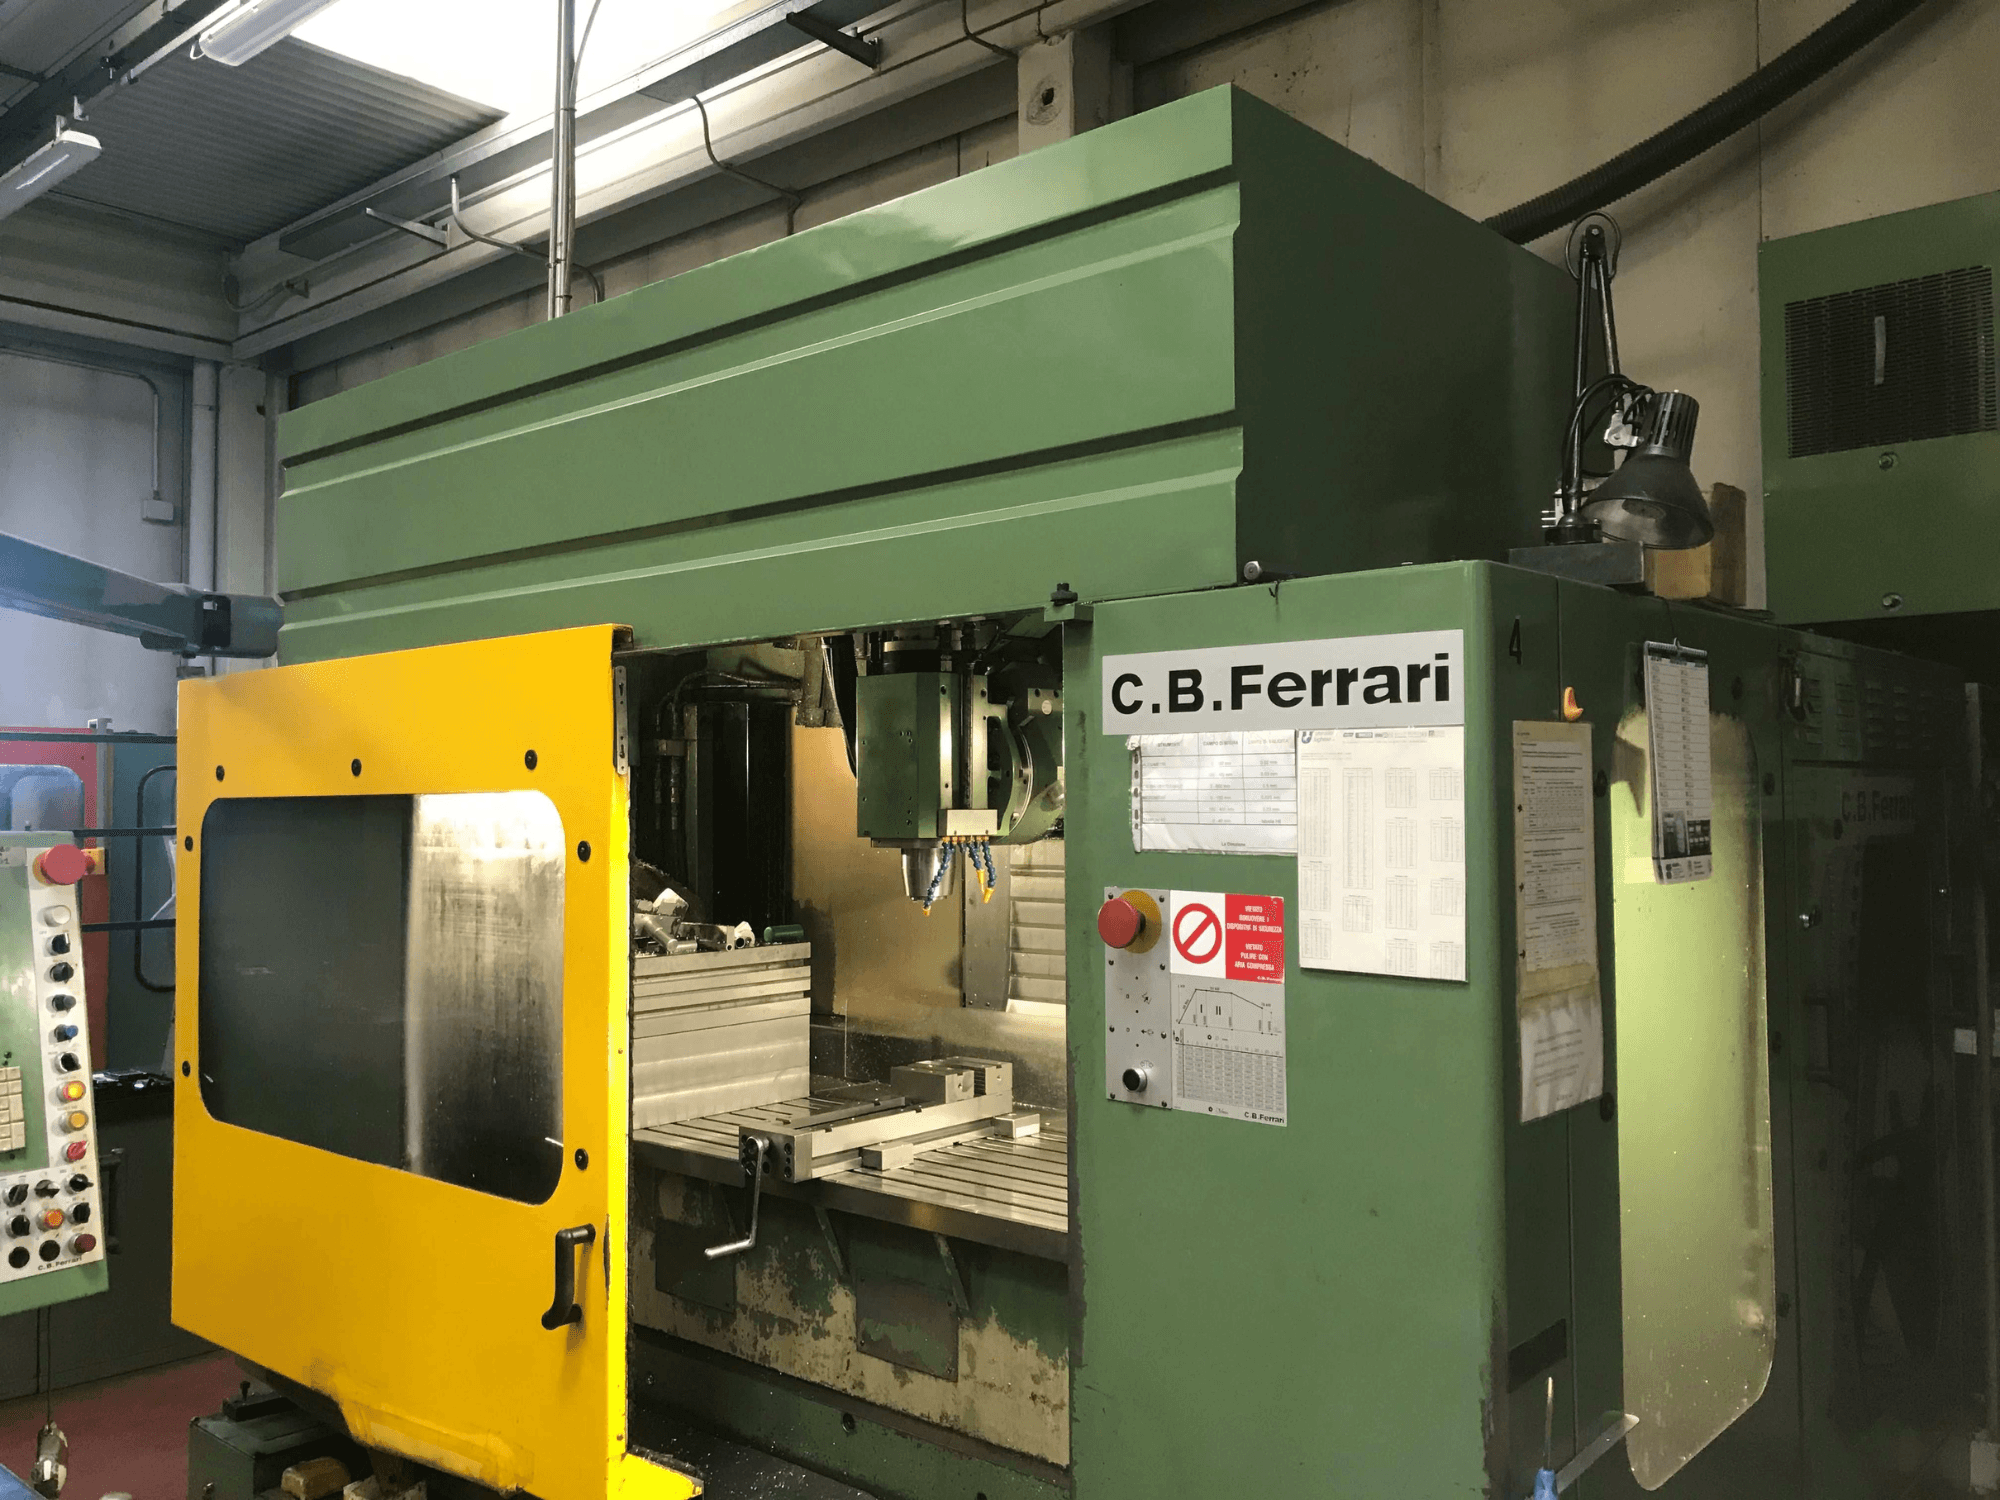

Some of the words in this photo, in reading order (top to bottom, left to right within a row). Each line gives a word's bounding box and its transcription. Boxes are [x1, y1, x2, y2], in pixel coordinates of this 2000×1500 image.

[1508, 617, 1523, 665] 4
[1111, 652, 1450, 715] C.B.Ferrari
[1240, 952, 1257, 960] PULIRE
[1258, 953, 1268, 961] CON
[1245, 943, 1263, 951] VIETATO
